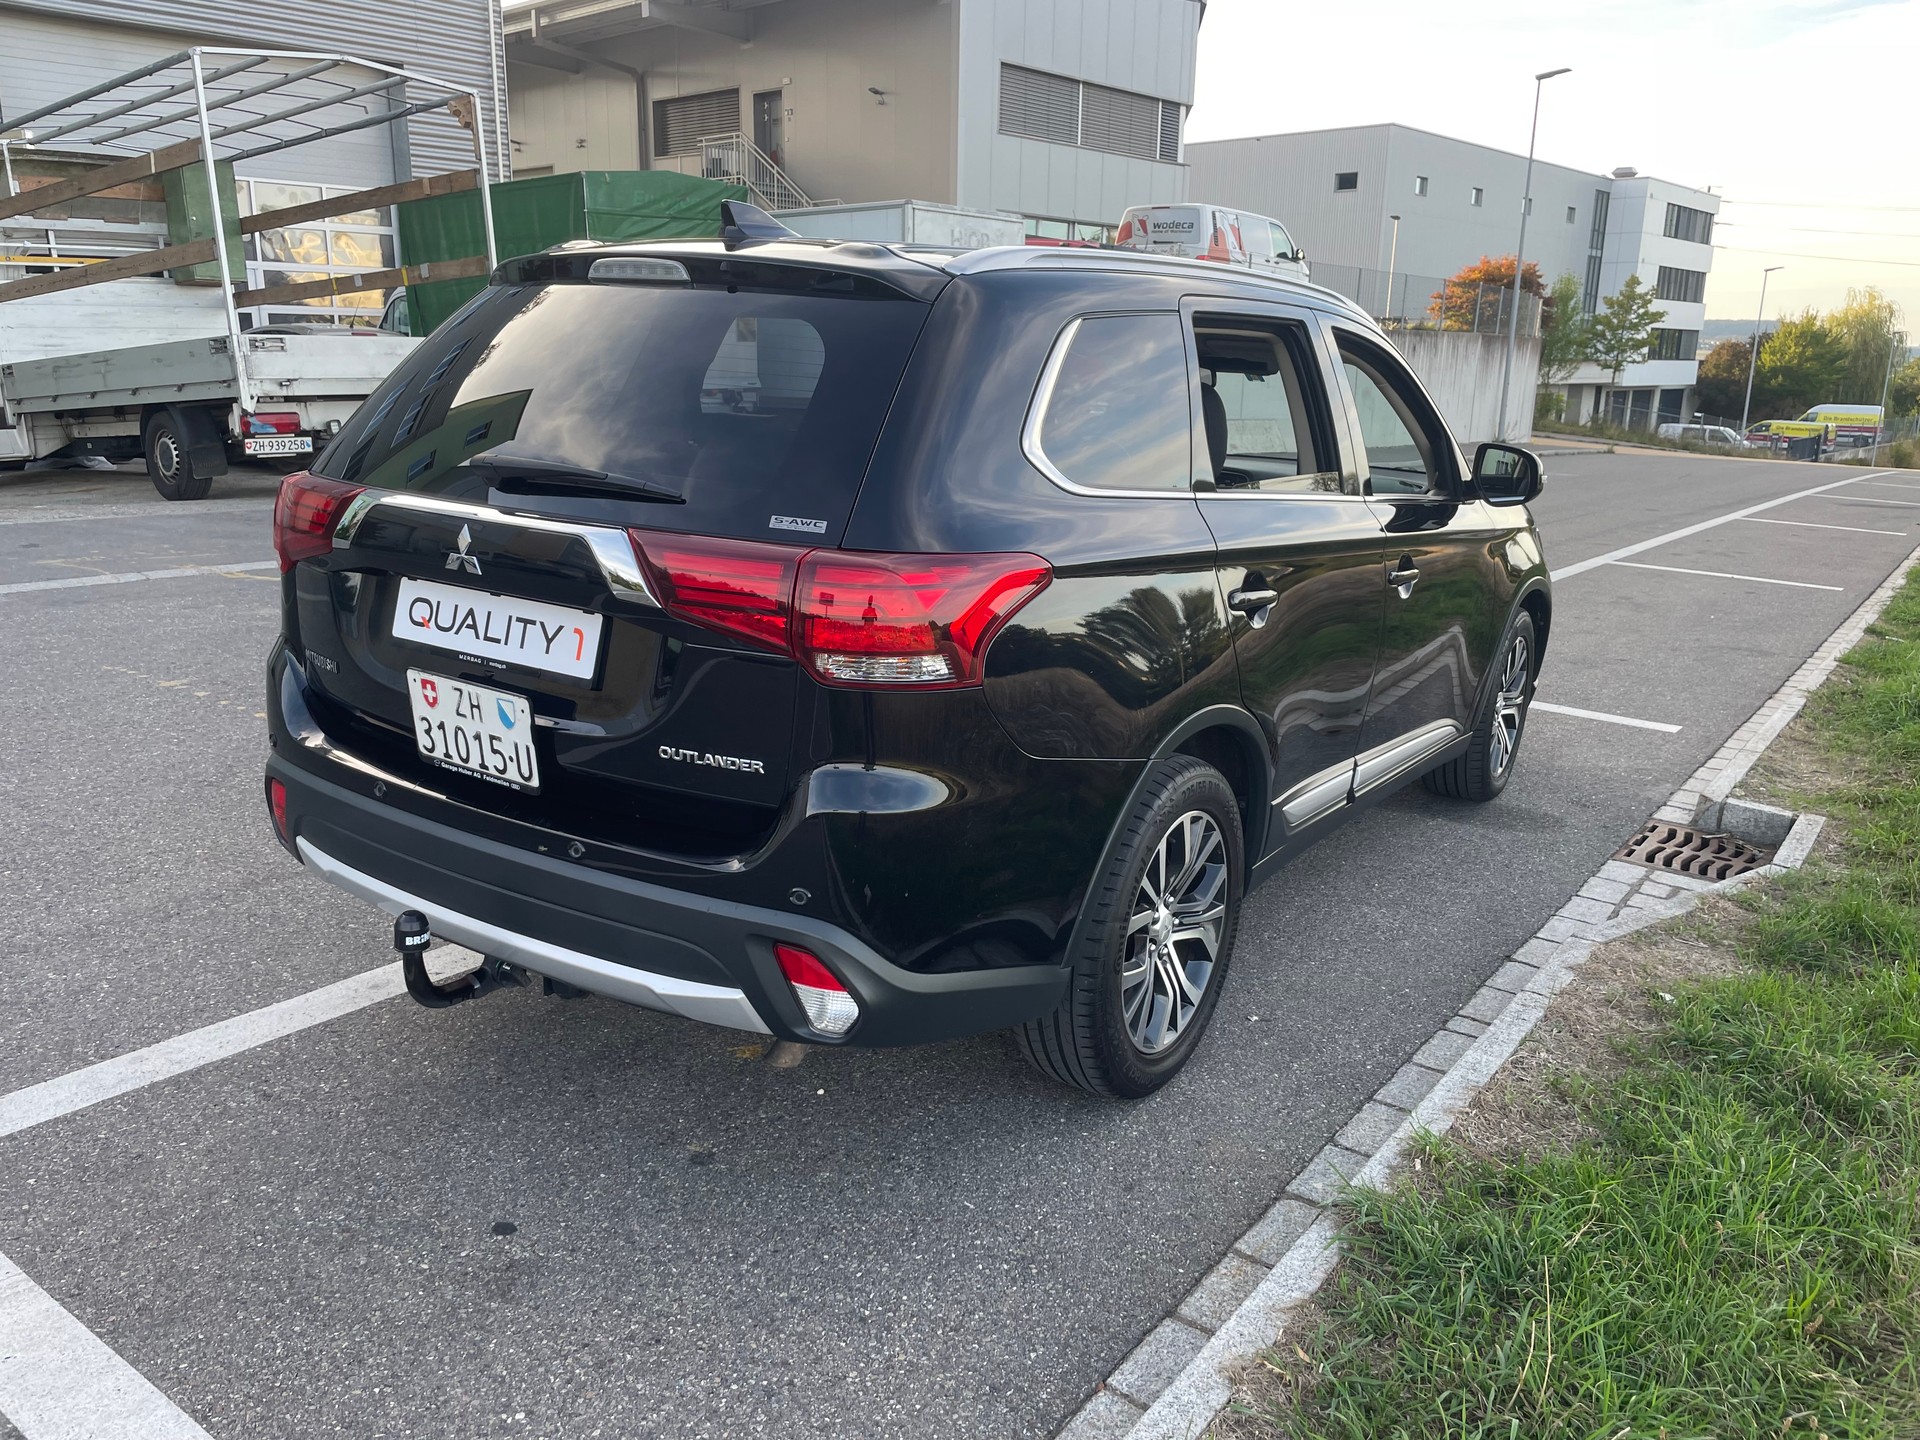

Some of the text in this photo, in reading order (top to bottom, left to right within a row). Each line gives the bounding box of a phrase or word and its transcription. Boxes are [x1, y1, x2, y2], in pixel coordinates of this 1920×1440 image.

[1152, 220, 1194, 229] wodeca
[774, 516, 824, 529] S-AWC
[452, 685, 484, 723] ZH
[658, 745, 765, 774] OUTLANDER
